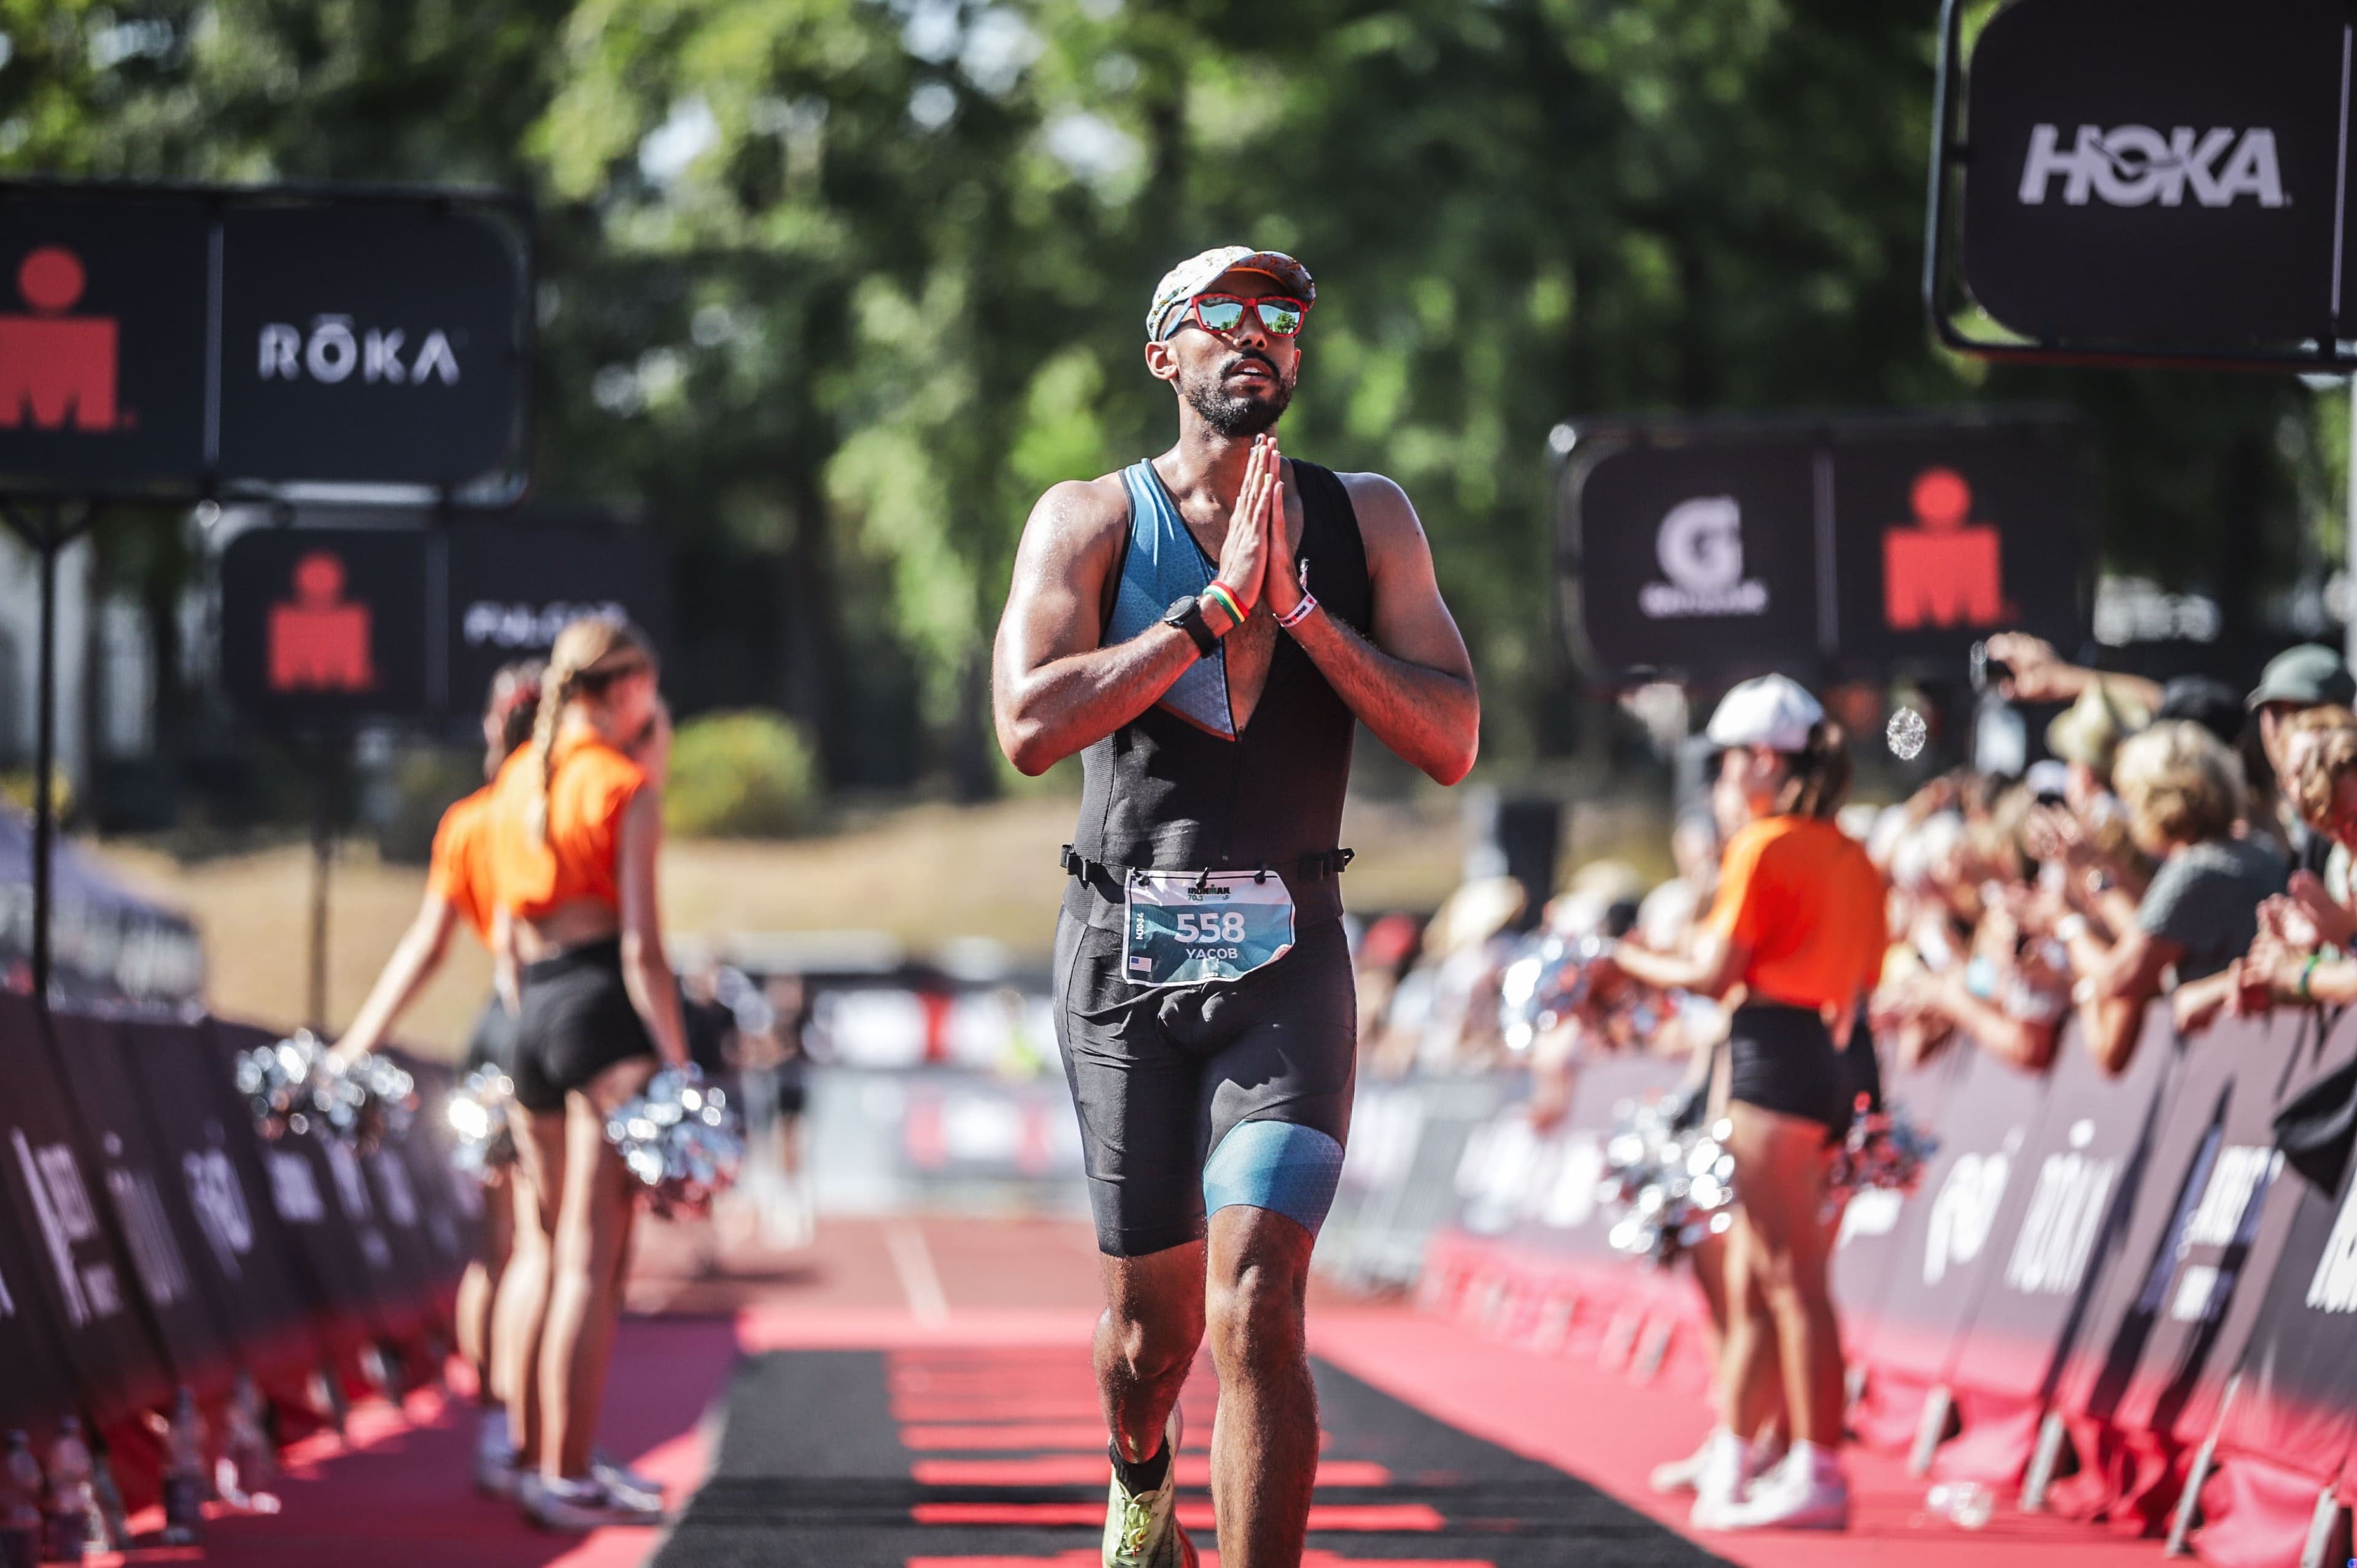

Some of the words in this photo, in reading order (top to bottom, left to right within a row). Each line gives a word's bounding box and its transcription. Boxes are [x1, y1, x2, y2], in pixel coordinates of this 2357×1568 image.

[2019, 125, 2283, 207] HOKA
[1188, 886, 1230, 894] IRONMAN
[1136, 912, 1145, 940] M30-34
[1174, 912, 1245, 943] 558
[1186, 948, 1238, 959] YACOB
